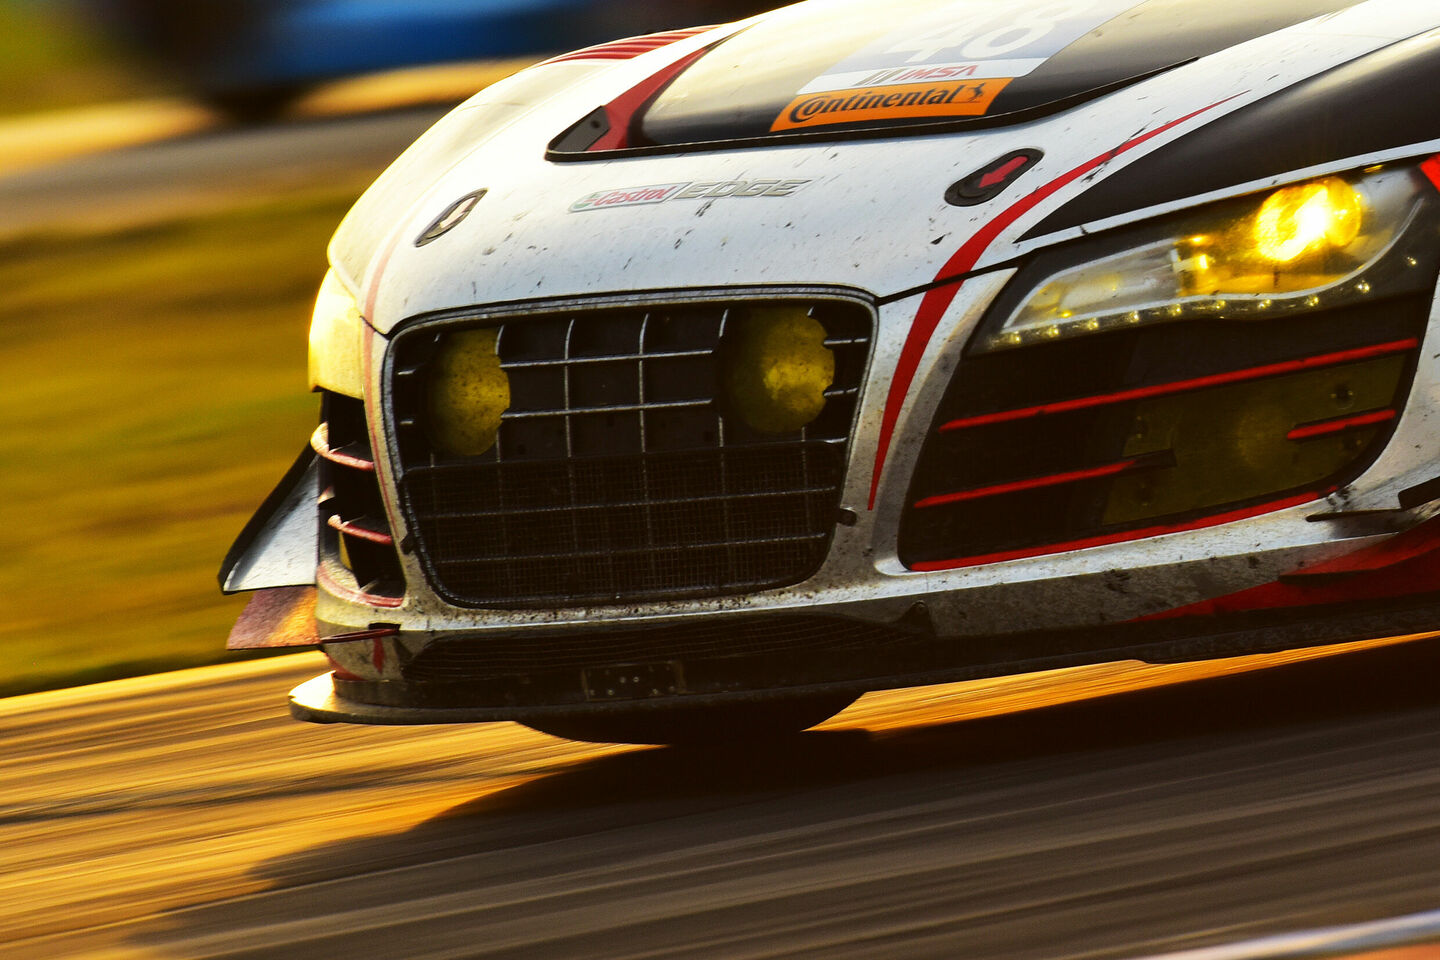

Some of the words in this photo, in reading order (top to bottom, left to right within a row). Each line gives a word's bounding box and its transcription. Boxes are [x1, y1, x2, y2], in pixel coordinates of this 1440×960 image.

[892, 64, 980, 82] IMSA
[789, 83, 963, 123] Continental
[594, 186, 677, 206] Castrol
[674, 179, 812, 200] EDGE
